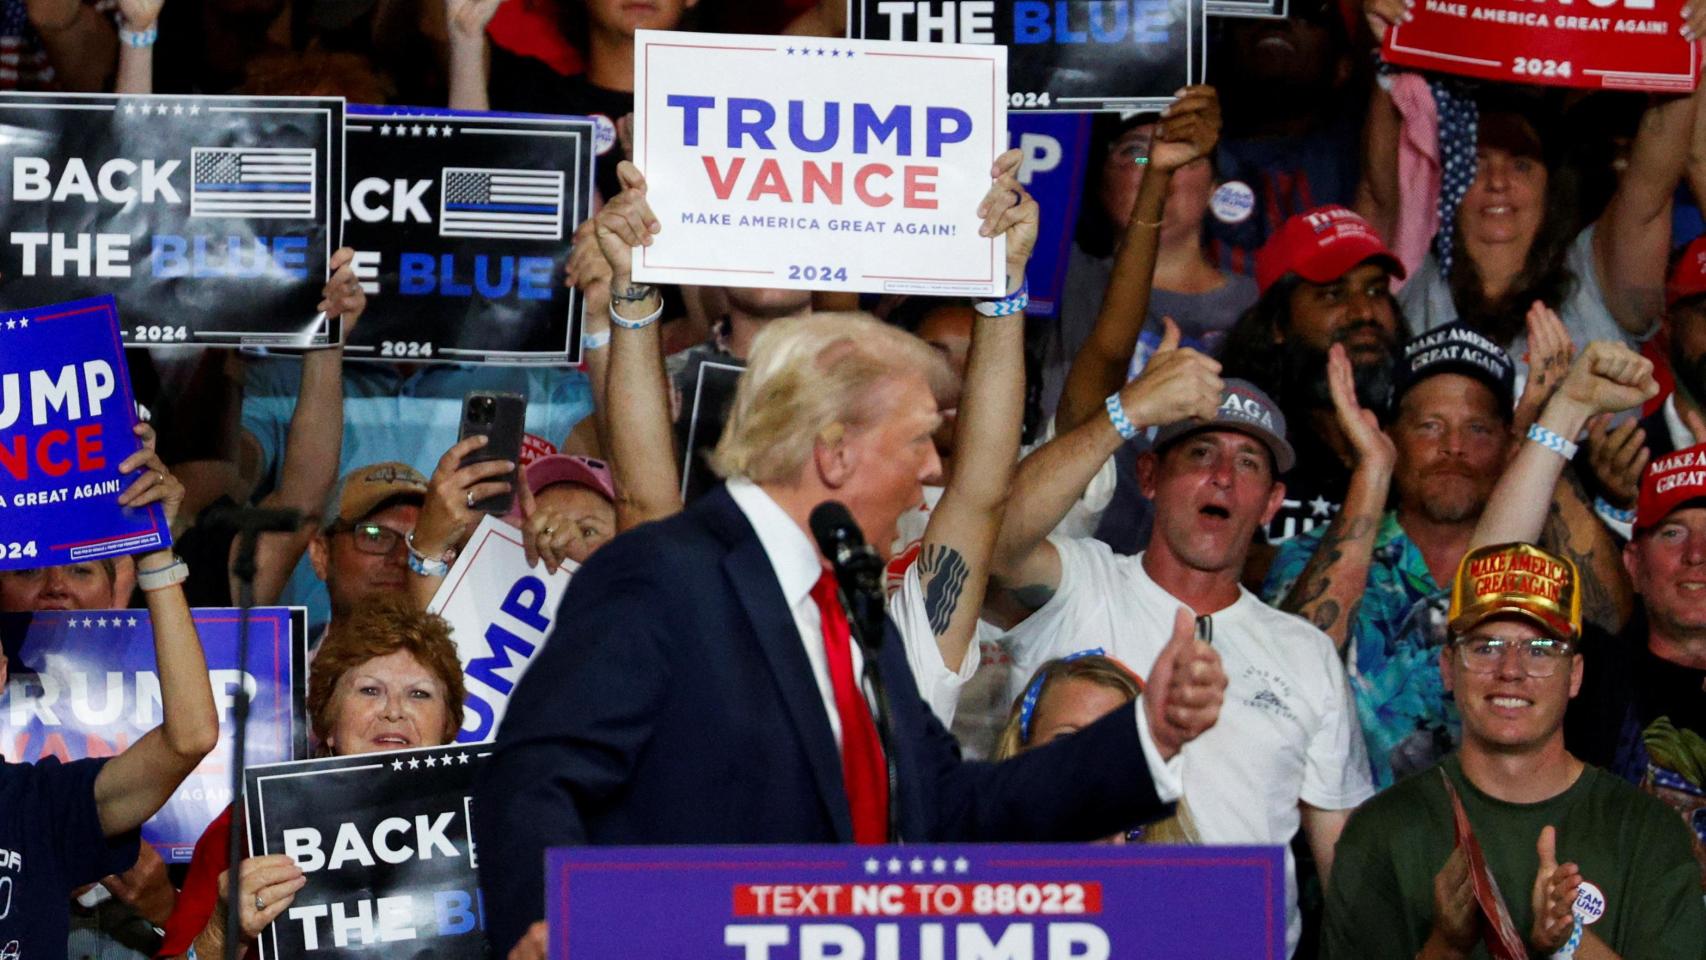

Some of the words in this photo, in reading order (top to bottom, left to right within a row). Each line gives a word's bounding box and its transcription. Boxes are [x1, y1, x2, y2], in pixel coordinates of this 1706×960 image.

[877, 1, 995, 44] THE
[1014, 0, 1169, 45] BLUE
[1425, 1, 1467, 18] MAKE
[1471, 7, 1549, 28] AMERICA
[1554, 15, 1611, 32] GREAT
[1614, 20, 1668, 34] AGAIN!
[1511, 56, 1572, 78] 2024
[667, 94, 973, 158] TRUMP
[12, 156, 182, 205] BACK
[701, 156, 939, 210] VANCE
[344, 177, 434, 223] CK
[681, 212, 732, 226] MAKE
[739, 215, 820, 230] AMERICA
[828, 219, 886, 233] GREAT
[893, 222, 957, 237] AGAIN!
[10, 232, 132, 278] THE
[151, 234, 309, 281] BLUE
[400, 252, 554, 300] BLUE
[788, 265, 848, 282] 2024
[134, 325, 188, 341] 2024
[380, 341, 432, 357] 2024
[1411, 345, 1460, 371] GREAT
[1219, 393, 1273, 429] AGA
[1649, 452, 1695, 477] MAKE
[13, 489, 69, 507] GREAT
[73, 479, 120, 500] AGAIN!
[1656, 471, 1706, 494] GREAT
[1470, 553, 1506, 577] MAKE
[1475, 574, 1517, 597] GREAT
[1519, 575, 1561, 603] AGAIN
[283, 811, 462, 874] BACK
[750, 885, 842, 915] TEXT
[851, 884, 905, 915] NC
[912, 884, 964, 915] TO
[971, 883, 1085, 915] 88022
[1577, 887, 1603, 909] EAM
[288, 894, 417, 952] THE
